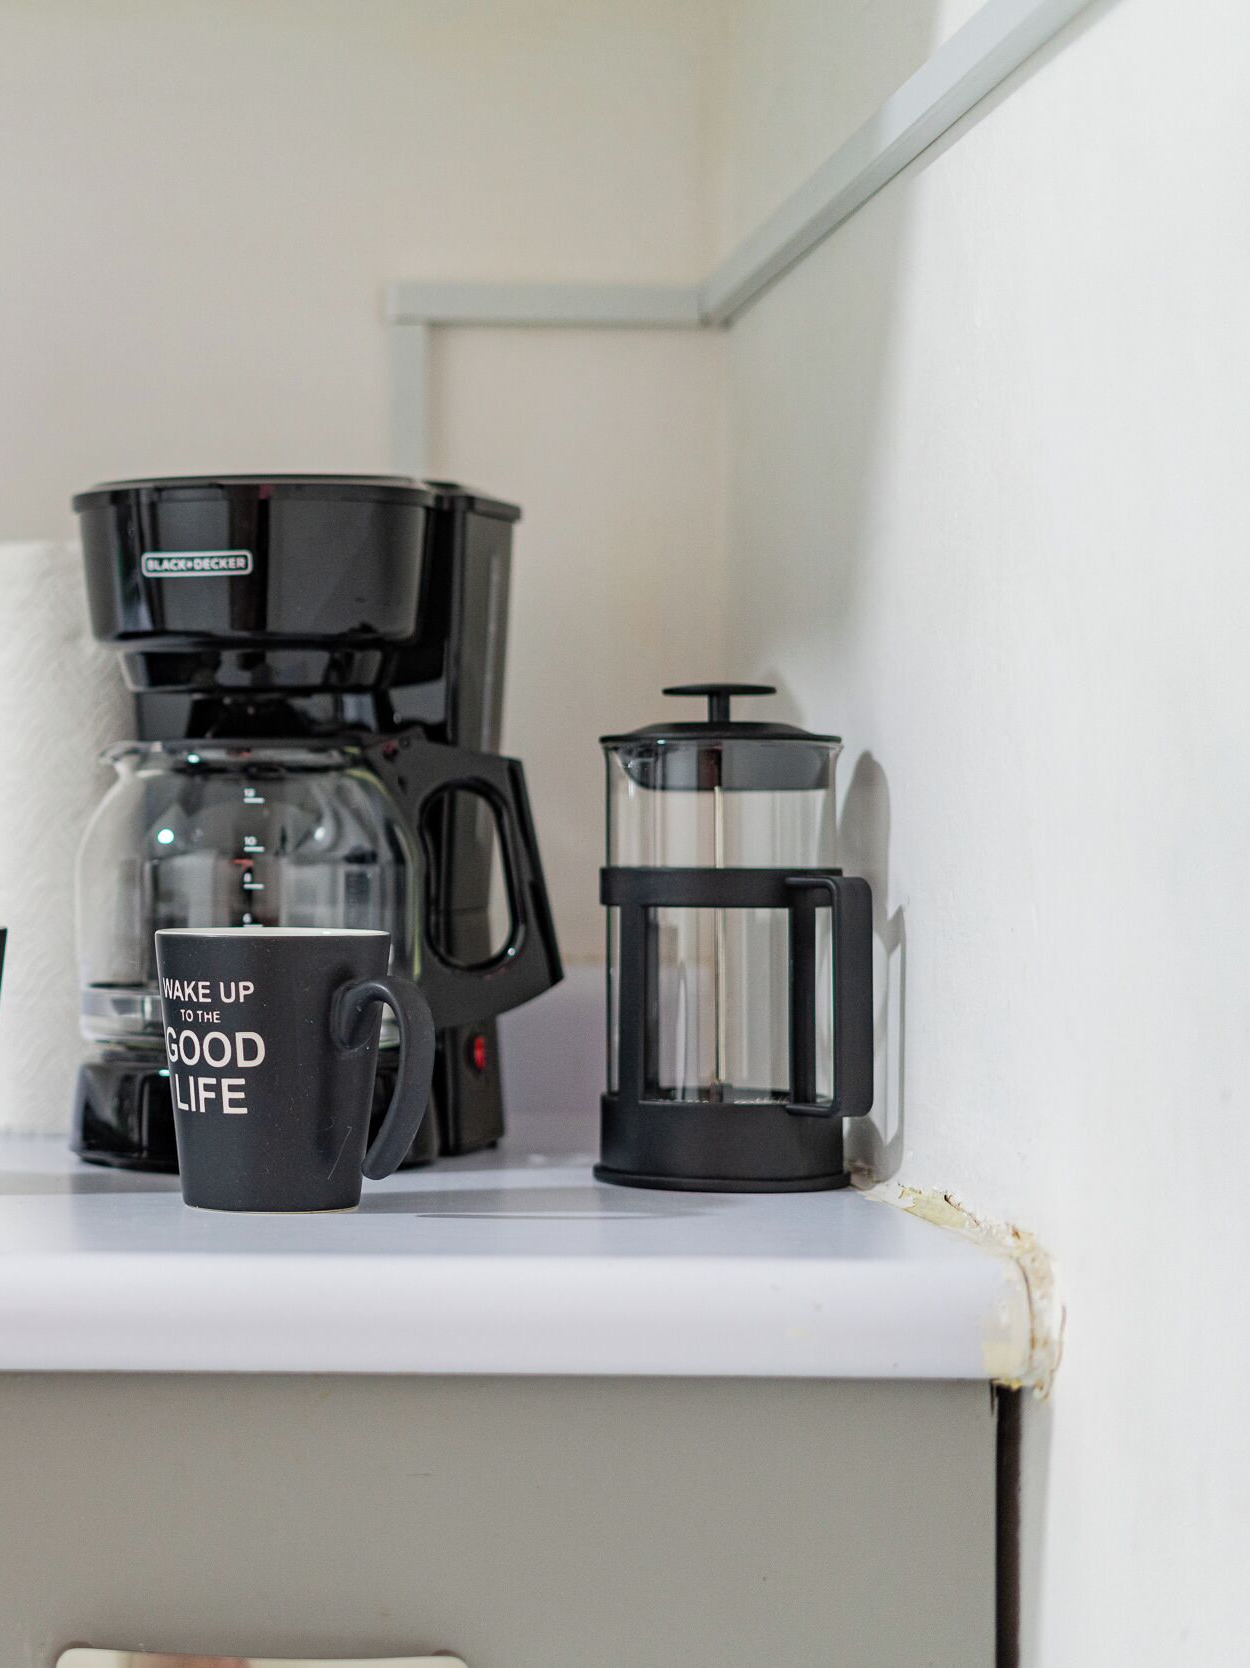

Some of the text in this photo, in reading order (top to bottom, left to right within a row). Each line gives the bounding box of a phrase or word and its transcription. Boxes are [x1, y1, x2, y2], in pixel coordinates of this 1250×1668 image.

[244, 836, 257, 846] 10
[162, 977, 255, 1004] WAKE UP
[180, 1009, 221, 1023] TO THE
[166, 1026, 266, 1068] GOOD
[175, 1073, 248, 1115] LIFE
